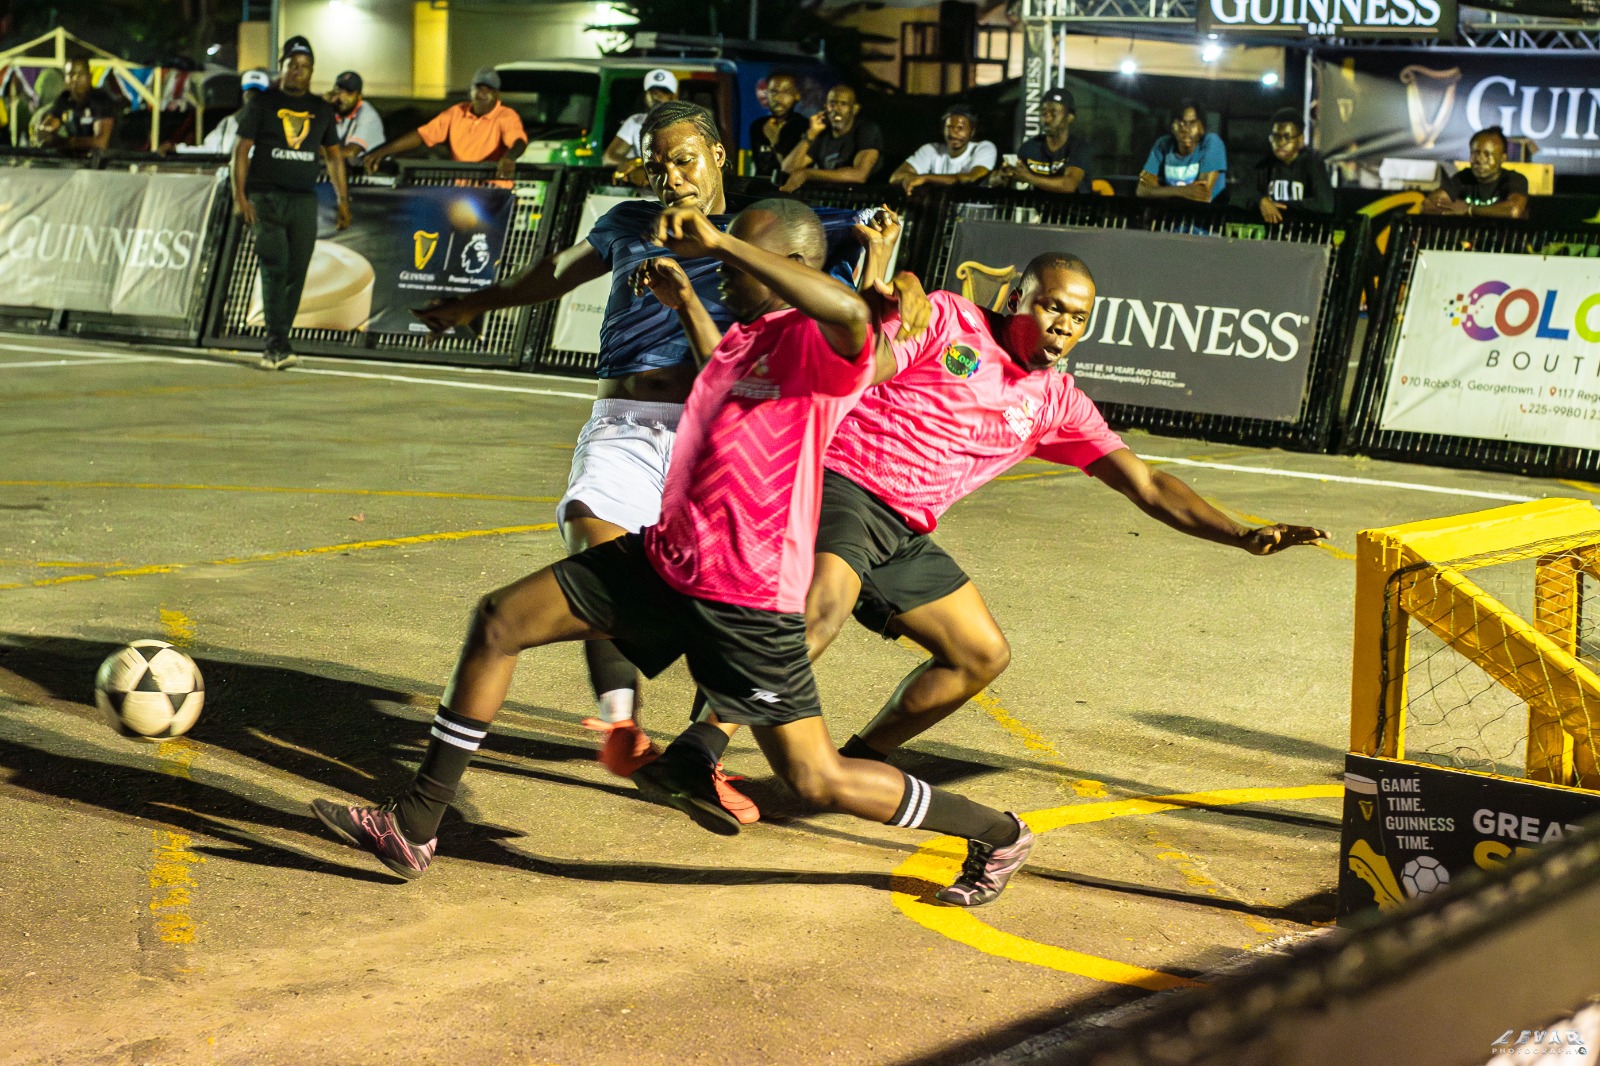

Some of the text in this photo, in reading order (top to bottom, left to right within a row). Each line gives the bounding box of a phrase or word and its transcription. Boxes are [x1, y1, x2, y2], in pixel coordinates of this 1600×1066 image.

[1307, 22, 1336, 35] BAR
[1023, 56, 1042, 142] UINNESS
[8, 214, 195, 270] GUINNESS
[1408, 376, 1420, 386] 70
[1381, 778, 1421, 793] GAME
[1386, 797, 1425, 812] TIME.
[1385, 816, 1455, 832] GUINNESS
[1396, 835, 1434, 850] TIME.
